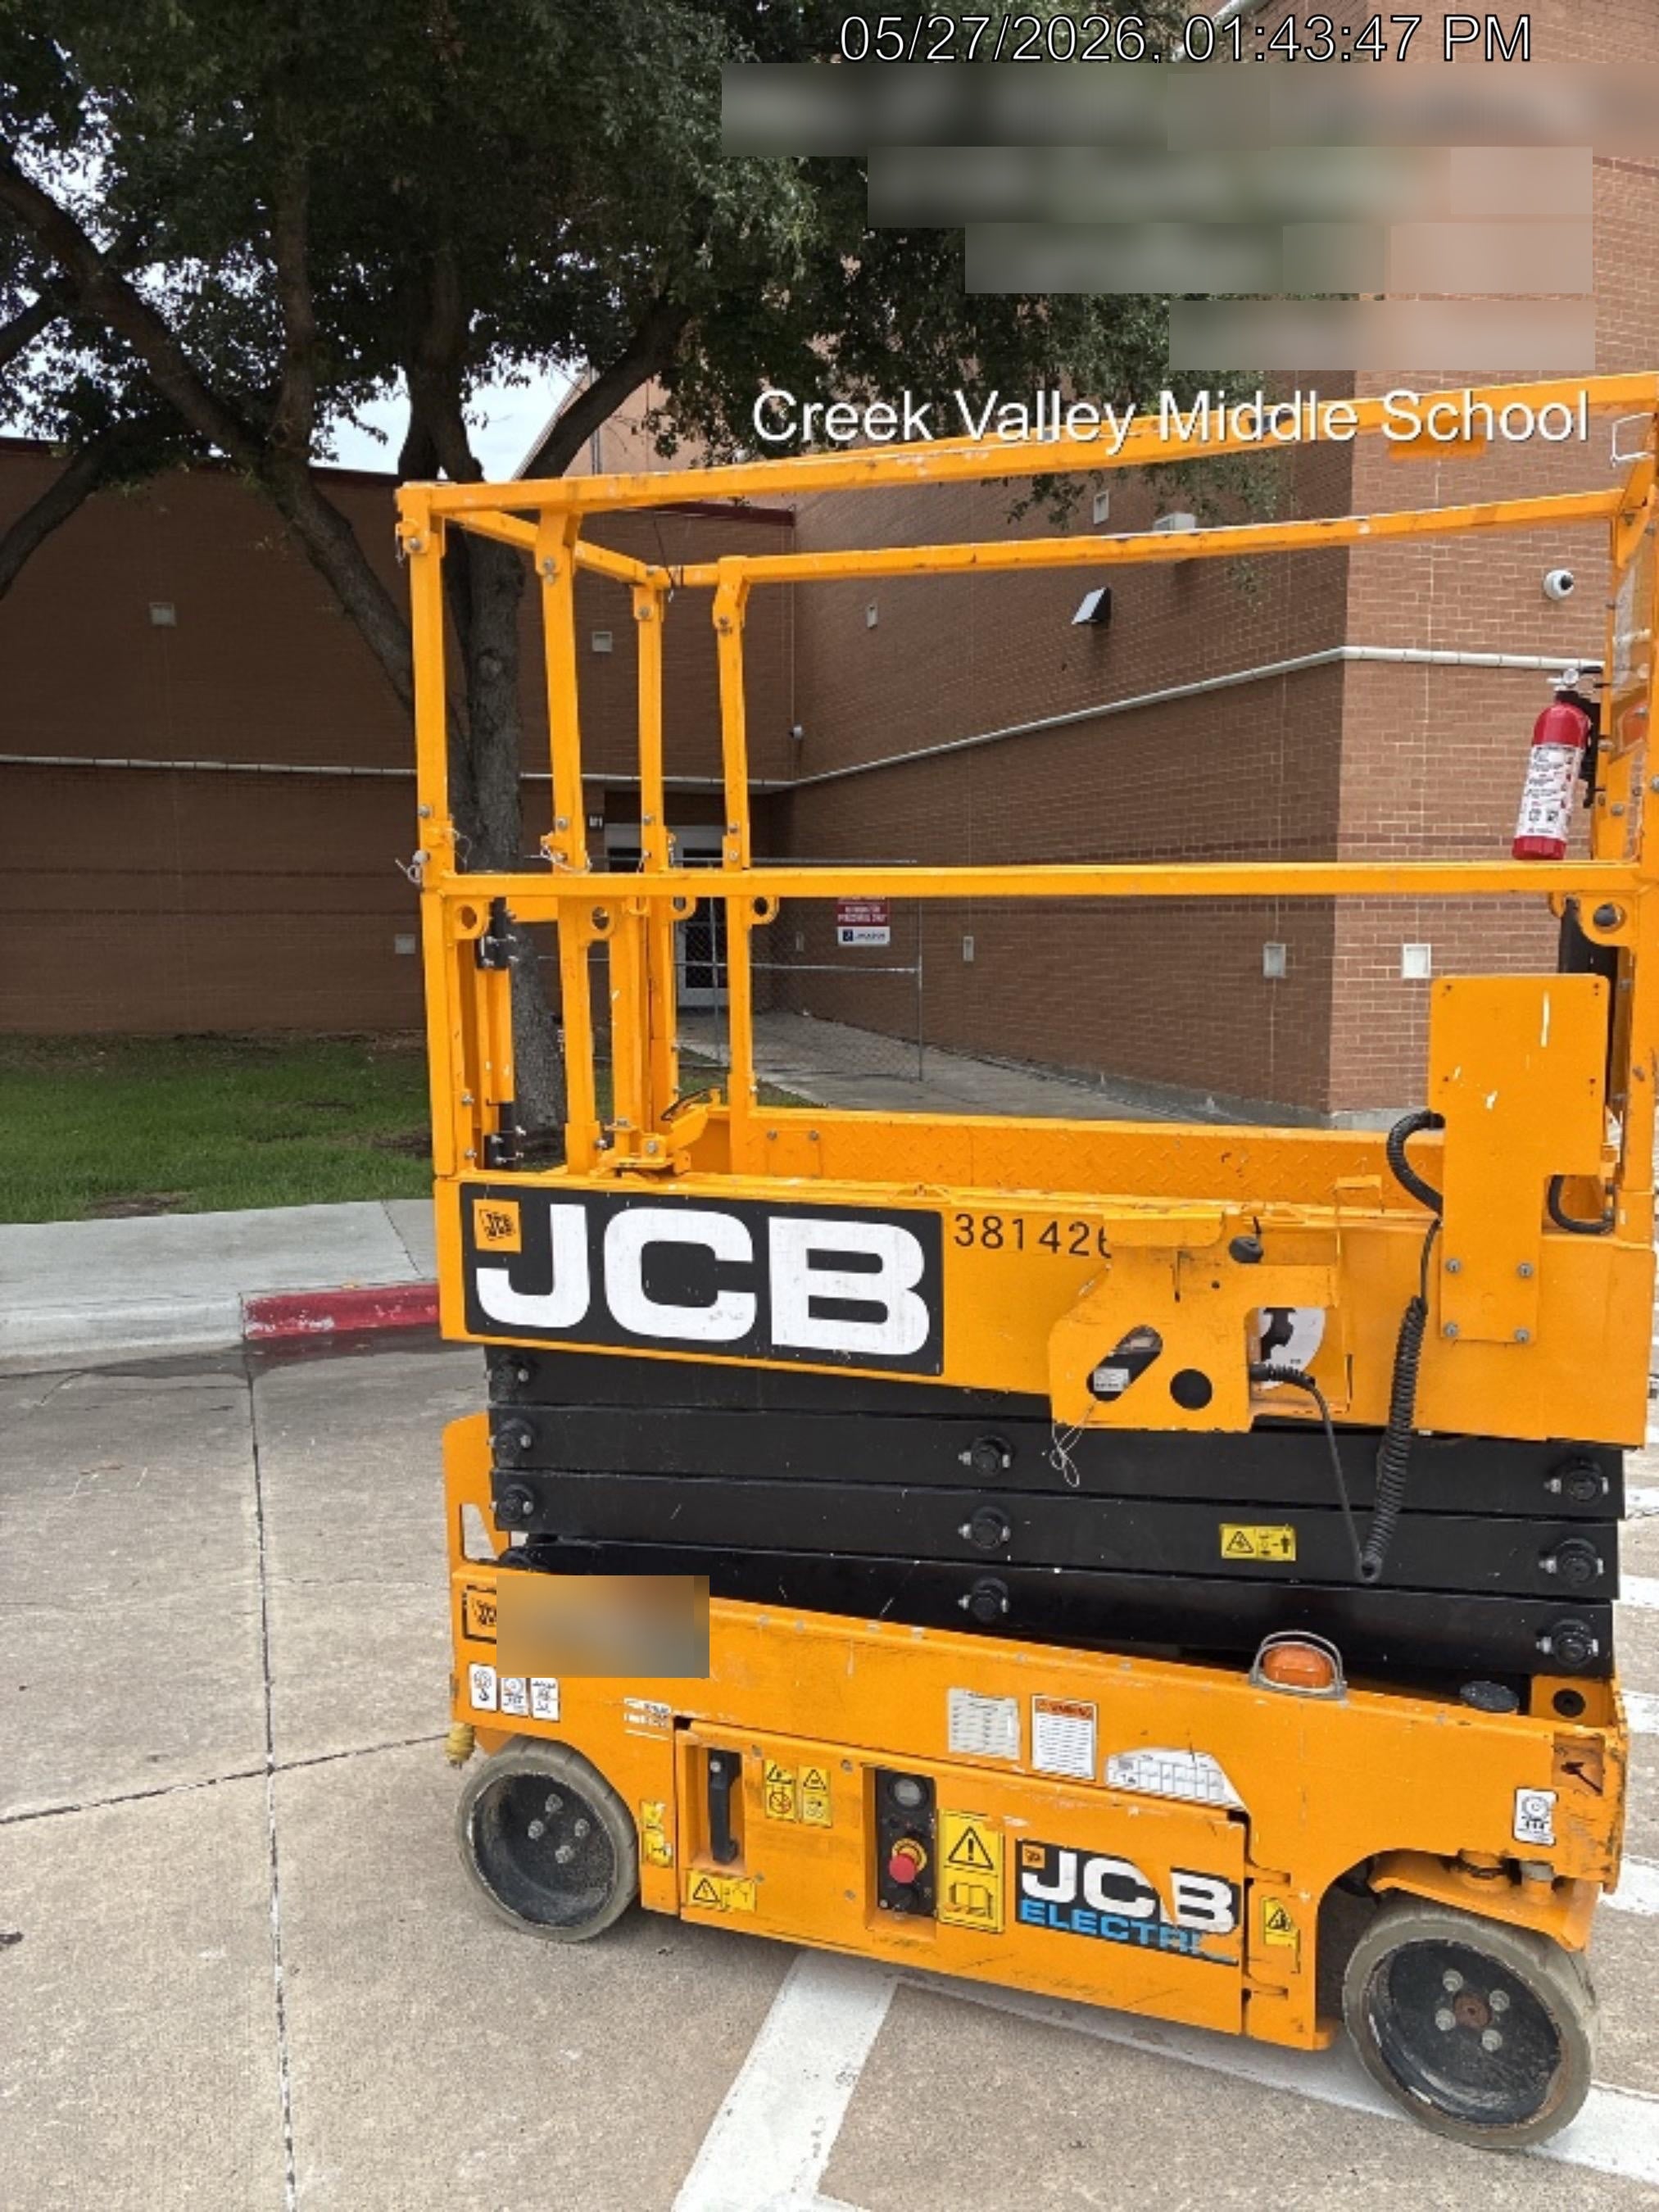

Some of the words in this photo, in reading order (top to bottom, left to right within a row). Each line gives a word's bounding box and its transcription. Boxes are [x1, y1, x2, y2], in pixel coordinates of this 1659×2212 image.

[475, 1203, 931, 1357] JCB
[1019, 1899, 1206, 1956] ELECTRI
[1022, 1850, 1235, 1933] JCB
